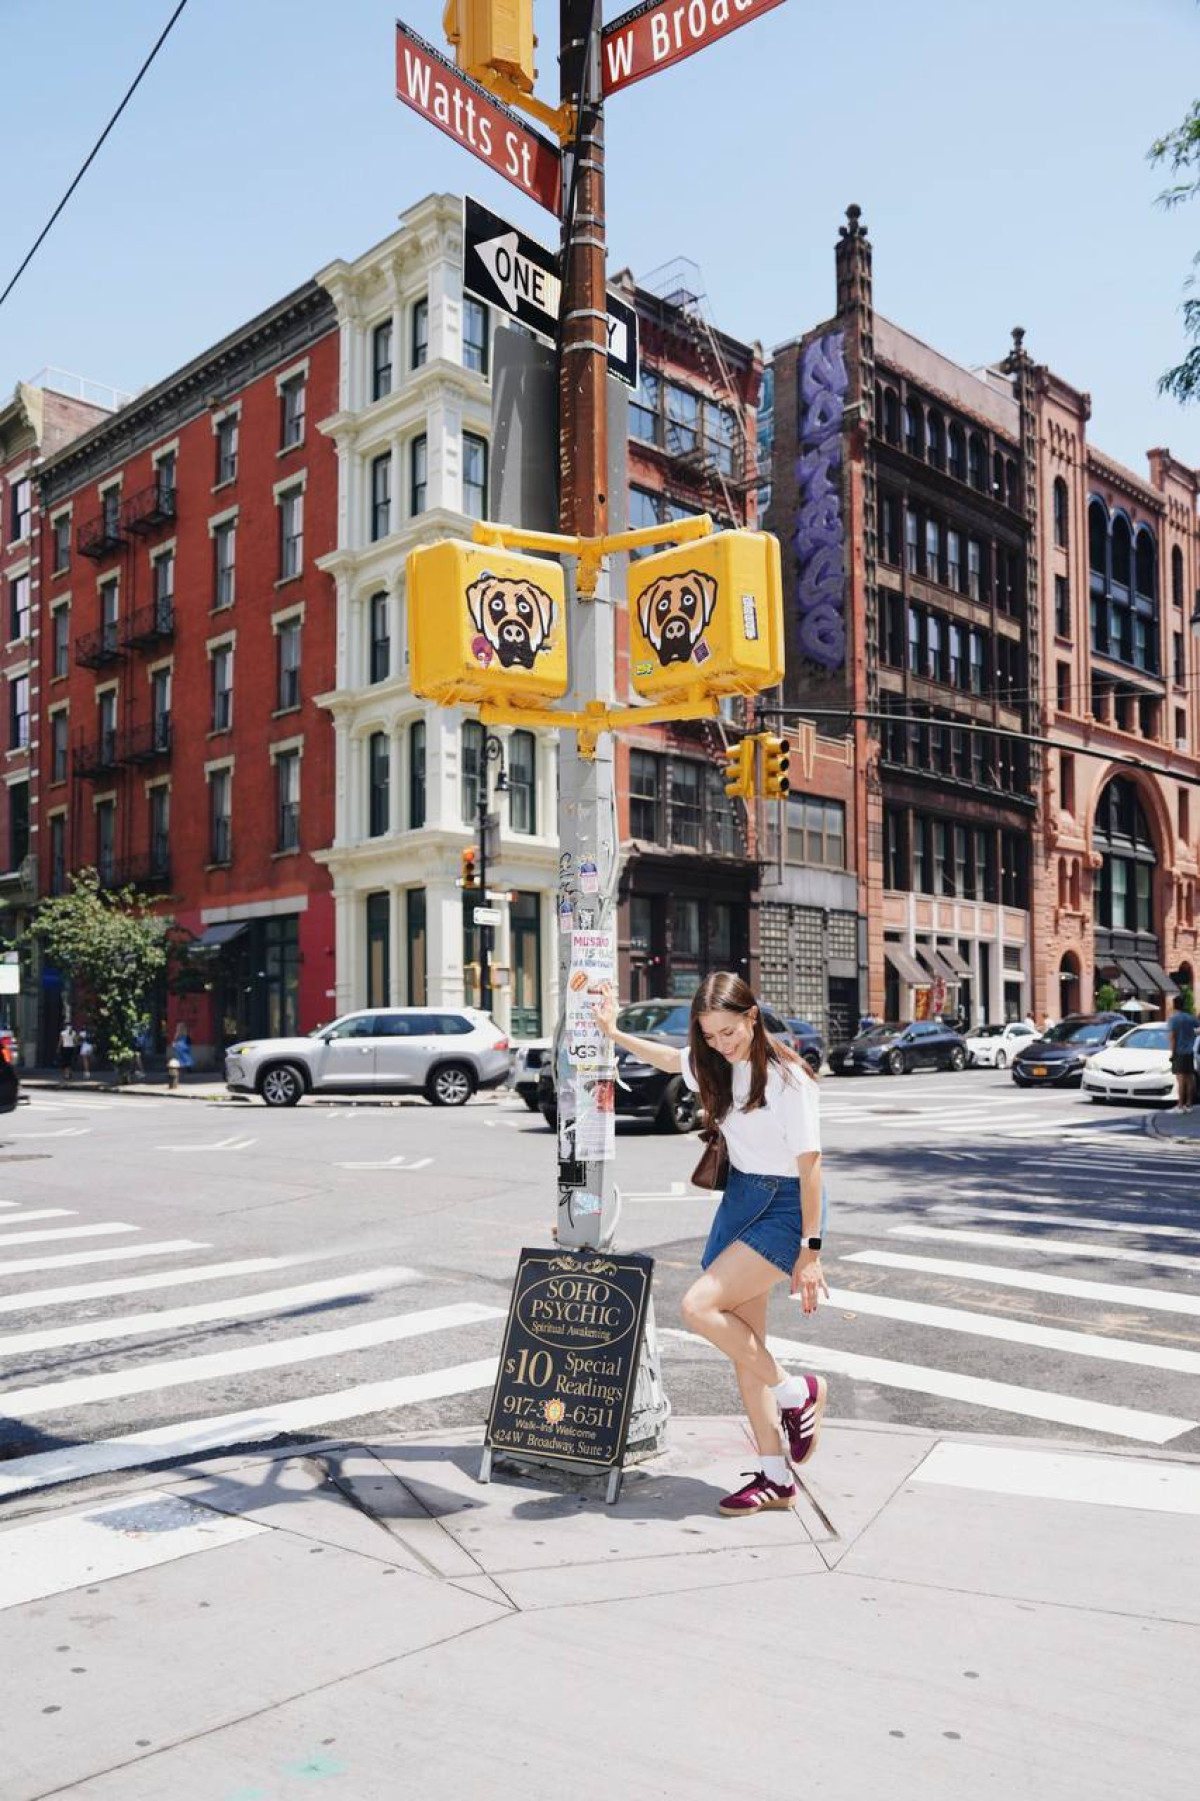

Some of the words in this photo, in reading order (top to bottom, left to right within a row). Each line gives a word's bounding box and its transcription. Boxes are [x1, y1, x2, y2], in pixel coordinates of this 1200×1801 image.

[606, 30, 634, 83] W
[404, 48, 492, 156] Watts
[505, 131, 532, 187] St
[495, 247, 545, 307] ONE
[546, 1280, 610, 1303] SOHO
[530, 1299, 621, 1326] PSYCHIC
[531, 1320, 565, 1335] Spiritual
[566, 1326, 612, 1341] Awakening
[505, 1348, 554, 1387] $10
[564, 1351, 623, 1377] Special
[555, 1374, 623, 1406] Readings
[515, 1418, 554, 1433] Walk-ins
[555, 1424, 597, 1439] Welcome
[526, 1433, 575, 1455] Broadway,
[577, 1441, 603, 1456] Suite
[604, 1445, 613, 1458] 2
